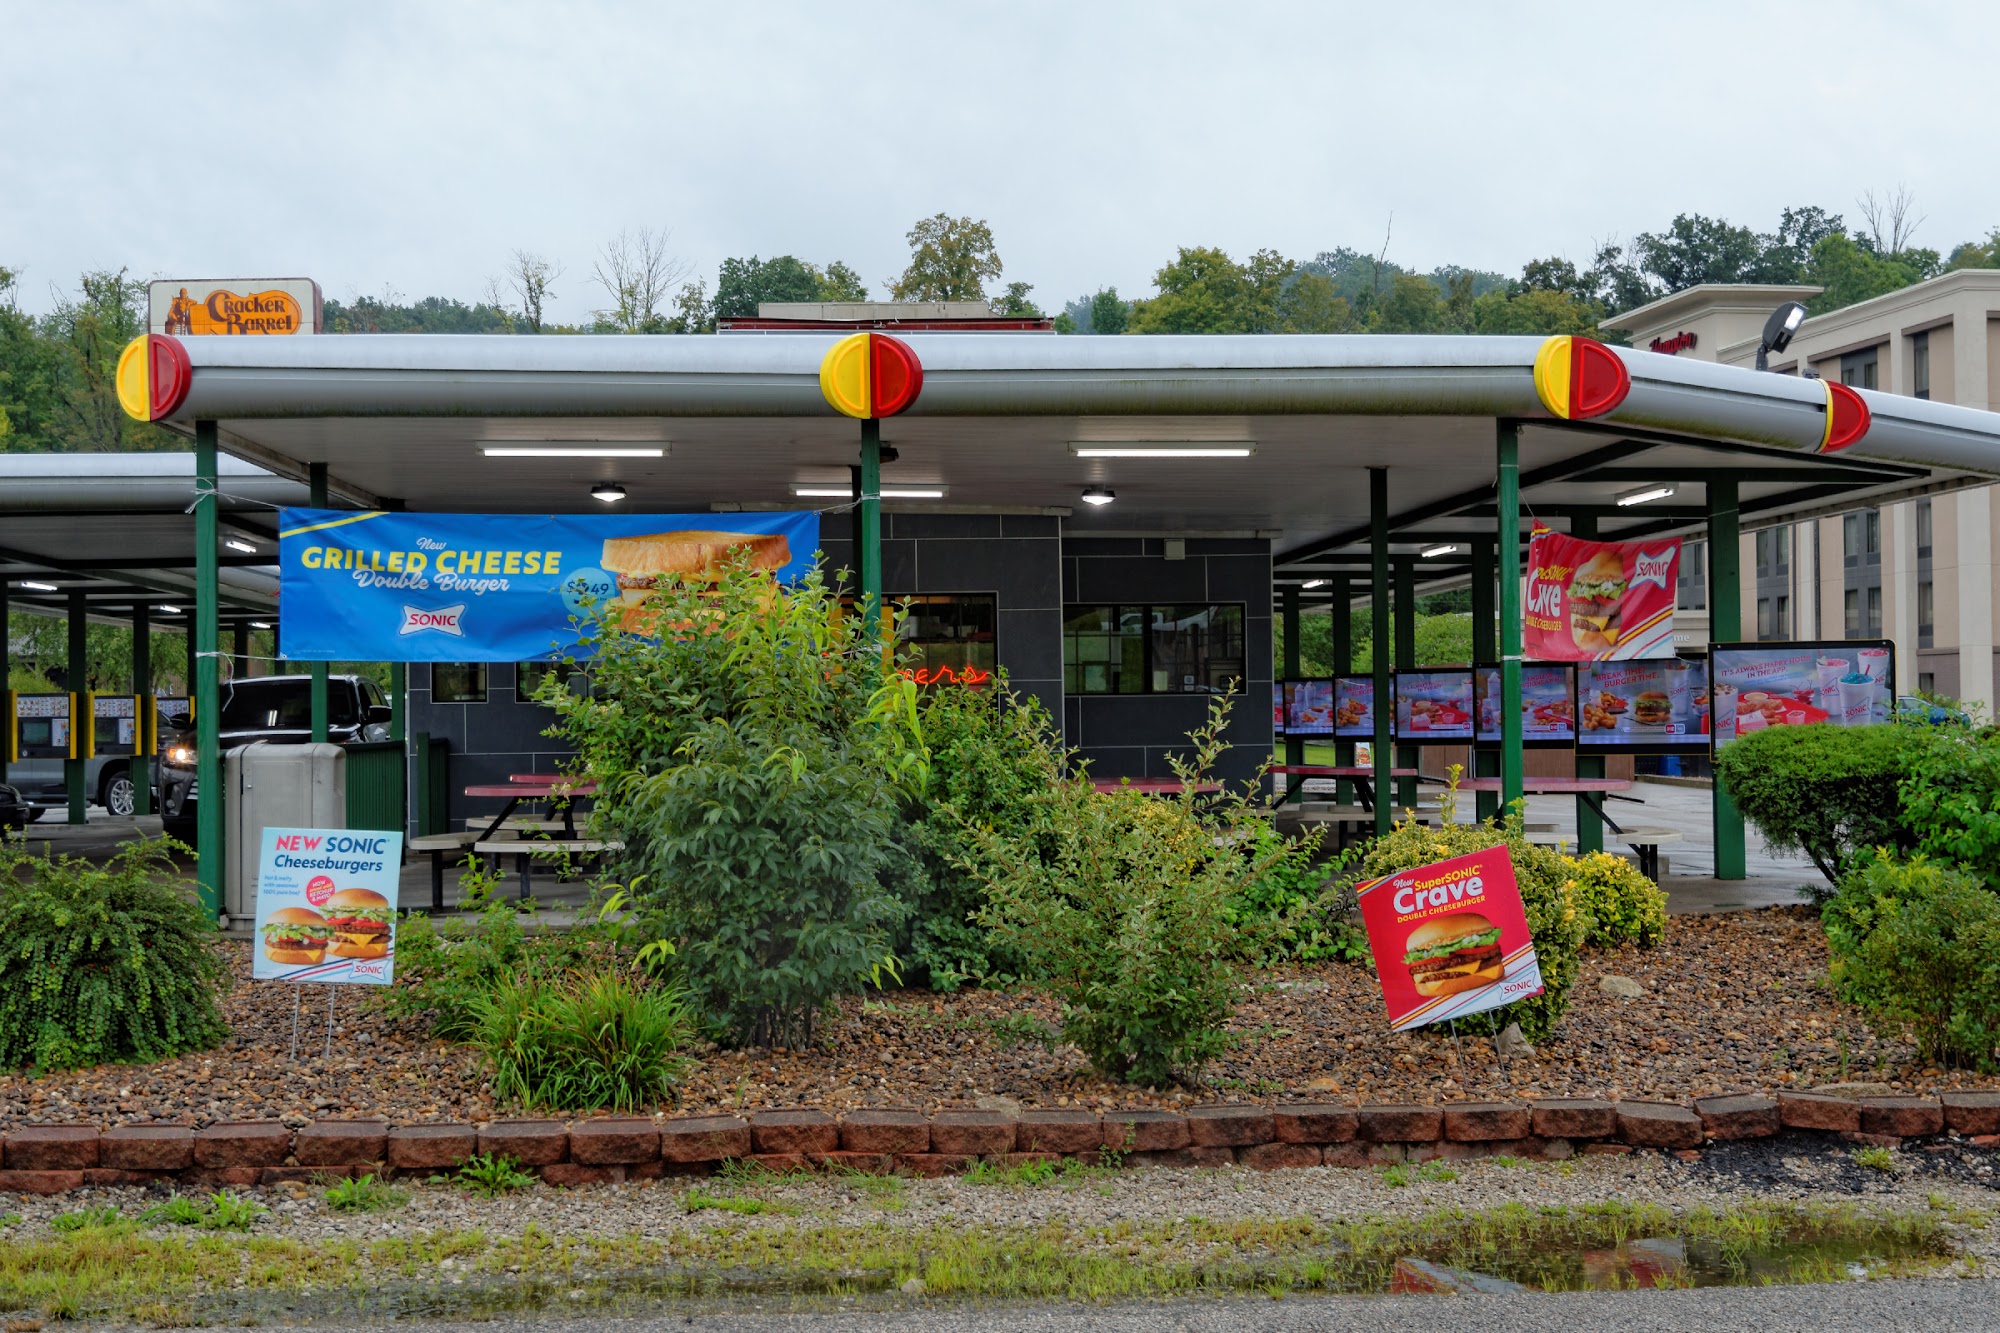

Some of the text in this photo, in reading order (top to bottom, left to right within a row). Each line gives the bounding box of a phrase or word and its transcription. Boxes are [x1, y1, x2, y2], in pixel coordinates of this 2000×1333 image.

[208, 292, 285, 322] Cracker
[227, 313, 292, 335] Barrel
[416, 536, 447, 551] New
[301, 546, 562, 575] GRILLED CHEESE
[1637, 561, 1668, 577] SONIC
[352, 568, 511, 596] Double Burger
[408, 613, 458, 627] SONIC
[1734, 663, 1763, 674] ALWAYS
[1764, 659, 1788, 669] HAPPY
[1789, 655, 1811, 664] HOUR
[1757, 669, 1771, 677] THE
[1596, 670, 1622, 682] BREAK
[1604, 676, 1637, 688] BURGER
[1845, 704, 1867, 718] SONIC
[275, 835, 387, 854] NEW SONIC
[274, 854, 383, 874] Cheeseburgers
[1393, 878, 1414, 889] New
[1415, 866, 1480, 891] SuperSONIC
[1393, 876, 1483, 915] Crave
[1397, 895, 1486, 923] DOUBLE CHEESEBURGER
[355, 965, 383, 974] SONIC
[1504, 979, 1532, 994] SONIC
